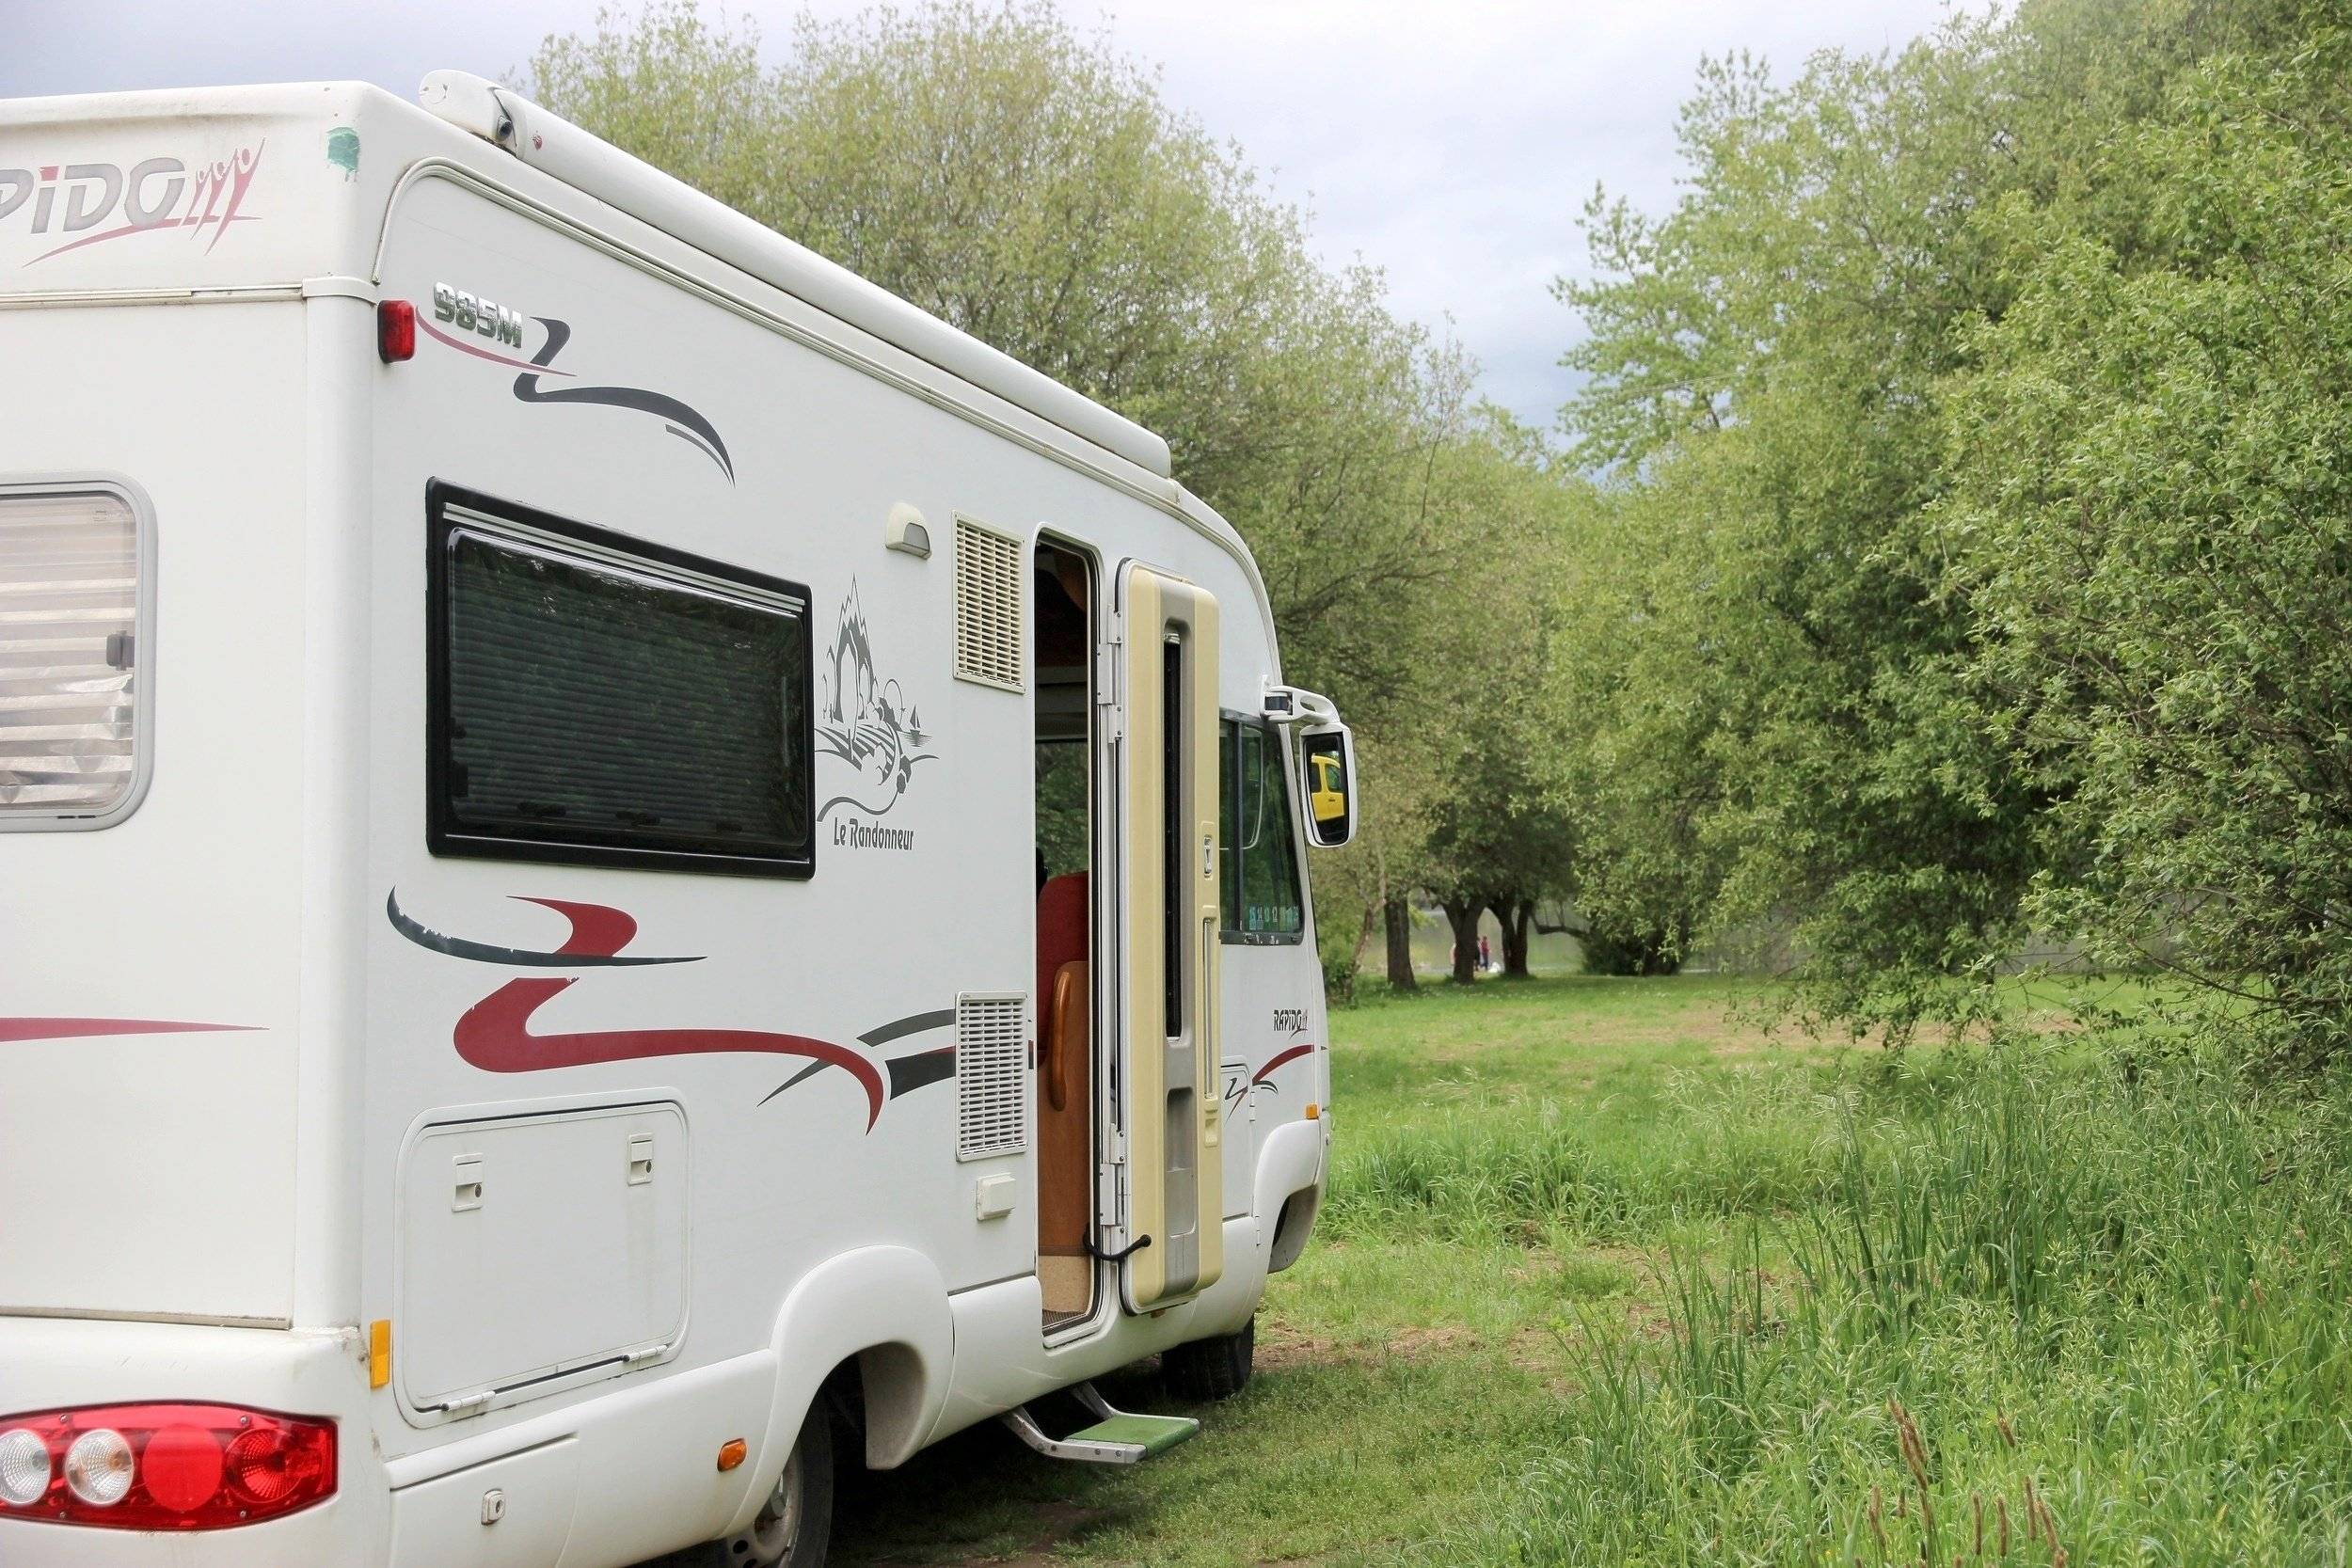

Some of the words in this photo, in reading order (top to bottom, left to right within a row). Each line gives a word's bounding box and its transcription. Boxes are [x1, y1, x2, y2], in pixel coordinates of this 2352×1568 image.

[433, 281, 522, 349] 985M
[834, 816, 847, 846] Le
[849, 817, 914, 851] Randonneur
